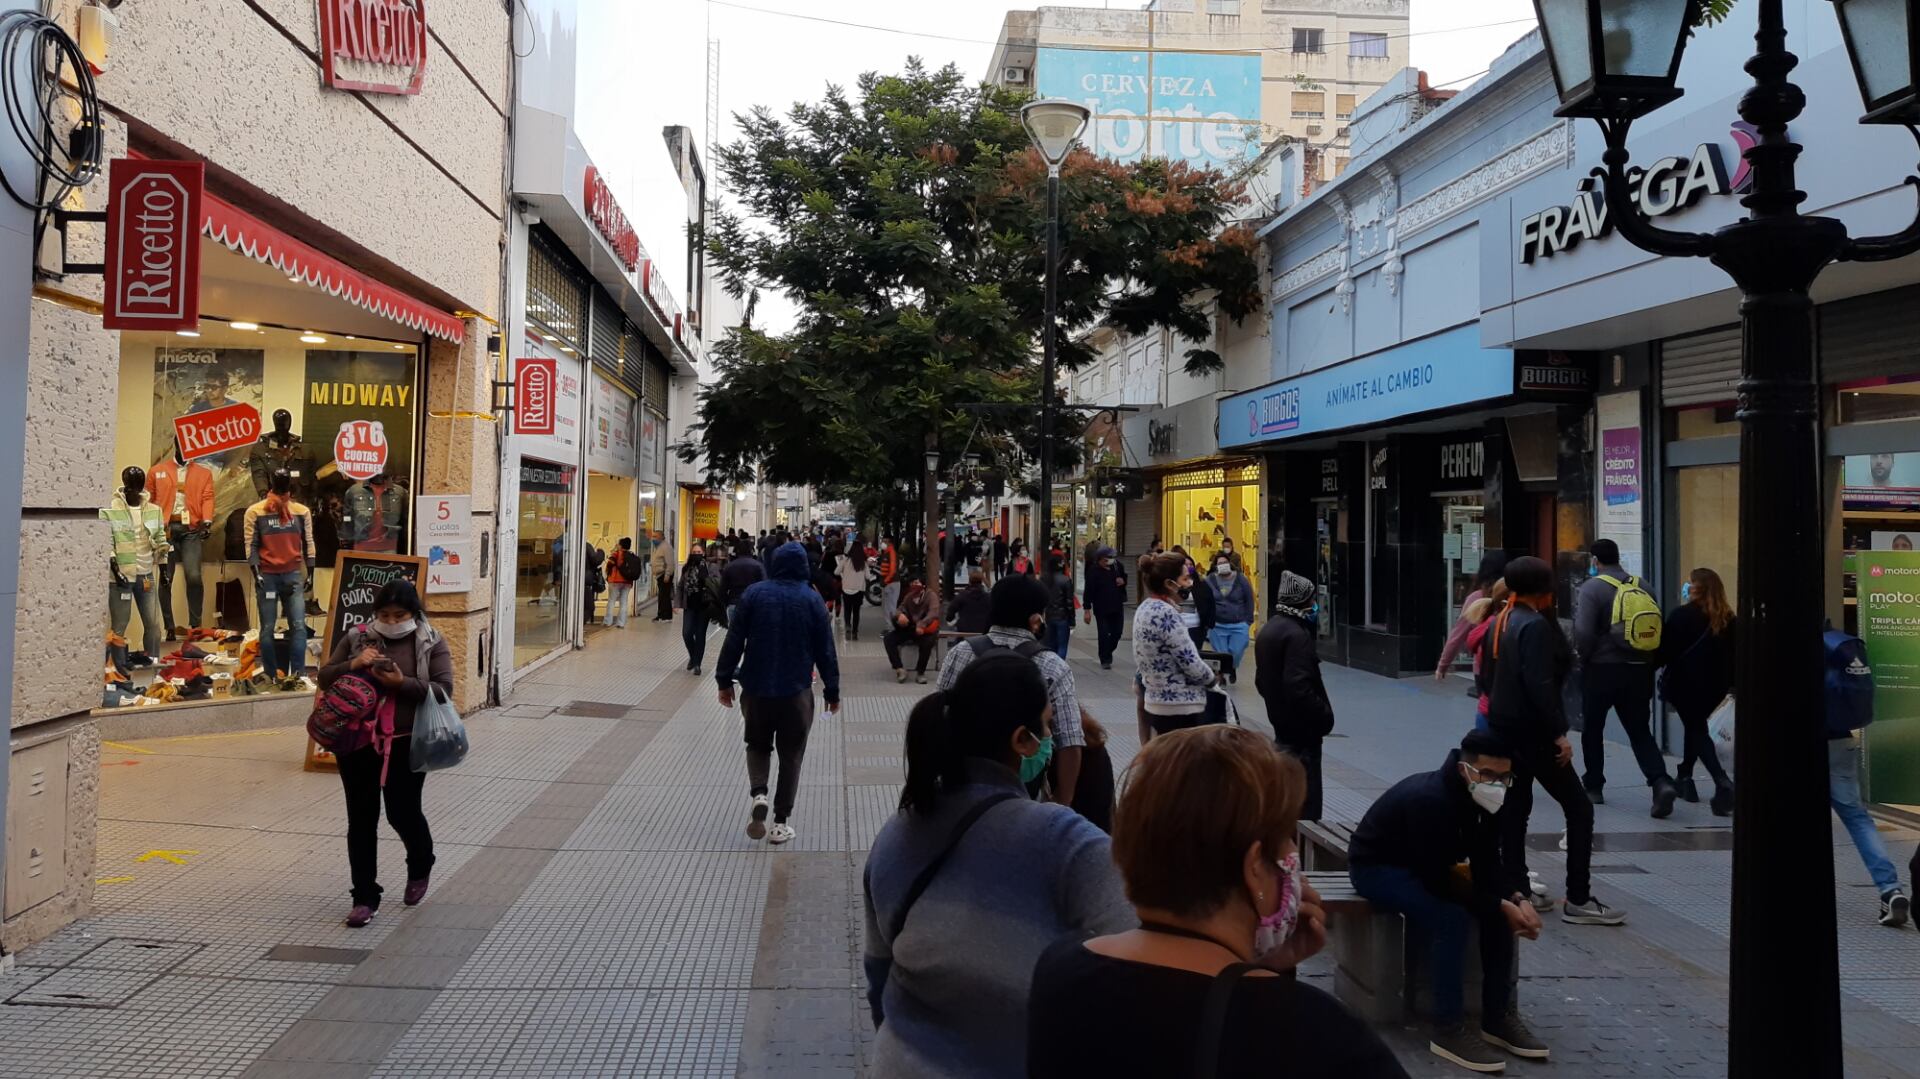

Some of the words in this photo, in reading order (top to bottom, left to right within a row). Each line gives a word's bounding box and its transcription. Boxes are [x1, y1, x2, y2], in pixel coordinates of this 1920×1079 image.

[333, 0, 418, 68] Ricetto
[1081, 73, 1217, 98] CERVEZA
[126, 190, 175, 308] Ricetto
[158, 351, 218, 364] mistral
[310, 382, 410, 407] MIDWAY
[1325, 381, 1368, 408] ANÍMATE
[1371, 378, 1383, 397] AL
[1388, 364, 1433, 392] CAMBIO
[523, 371, 545, 424] Ricetto
[1262, 389, 1299, 424] BURGOS
[178, 416, 253, 453] Ricetto
[340, 422, 355, 448] 3
[358, 427, 366, 443] Y
[370, 421, 384, 447] 6
[338, 461, 352, 471] SIN
[344, 449, 378, 462] CUOTAS
[1604, 457, 1635, 470] CRÉDITO
[1605, 472, 1638, 486] FRÁVEGA
[437, 501, 451, 520] 5
[429, 523, 460, 531] Cuotas
[341, 588, 375, 607] BOTAS
[1871, 617, 1902, 625] TRIPLE
